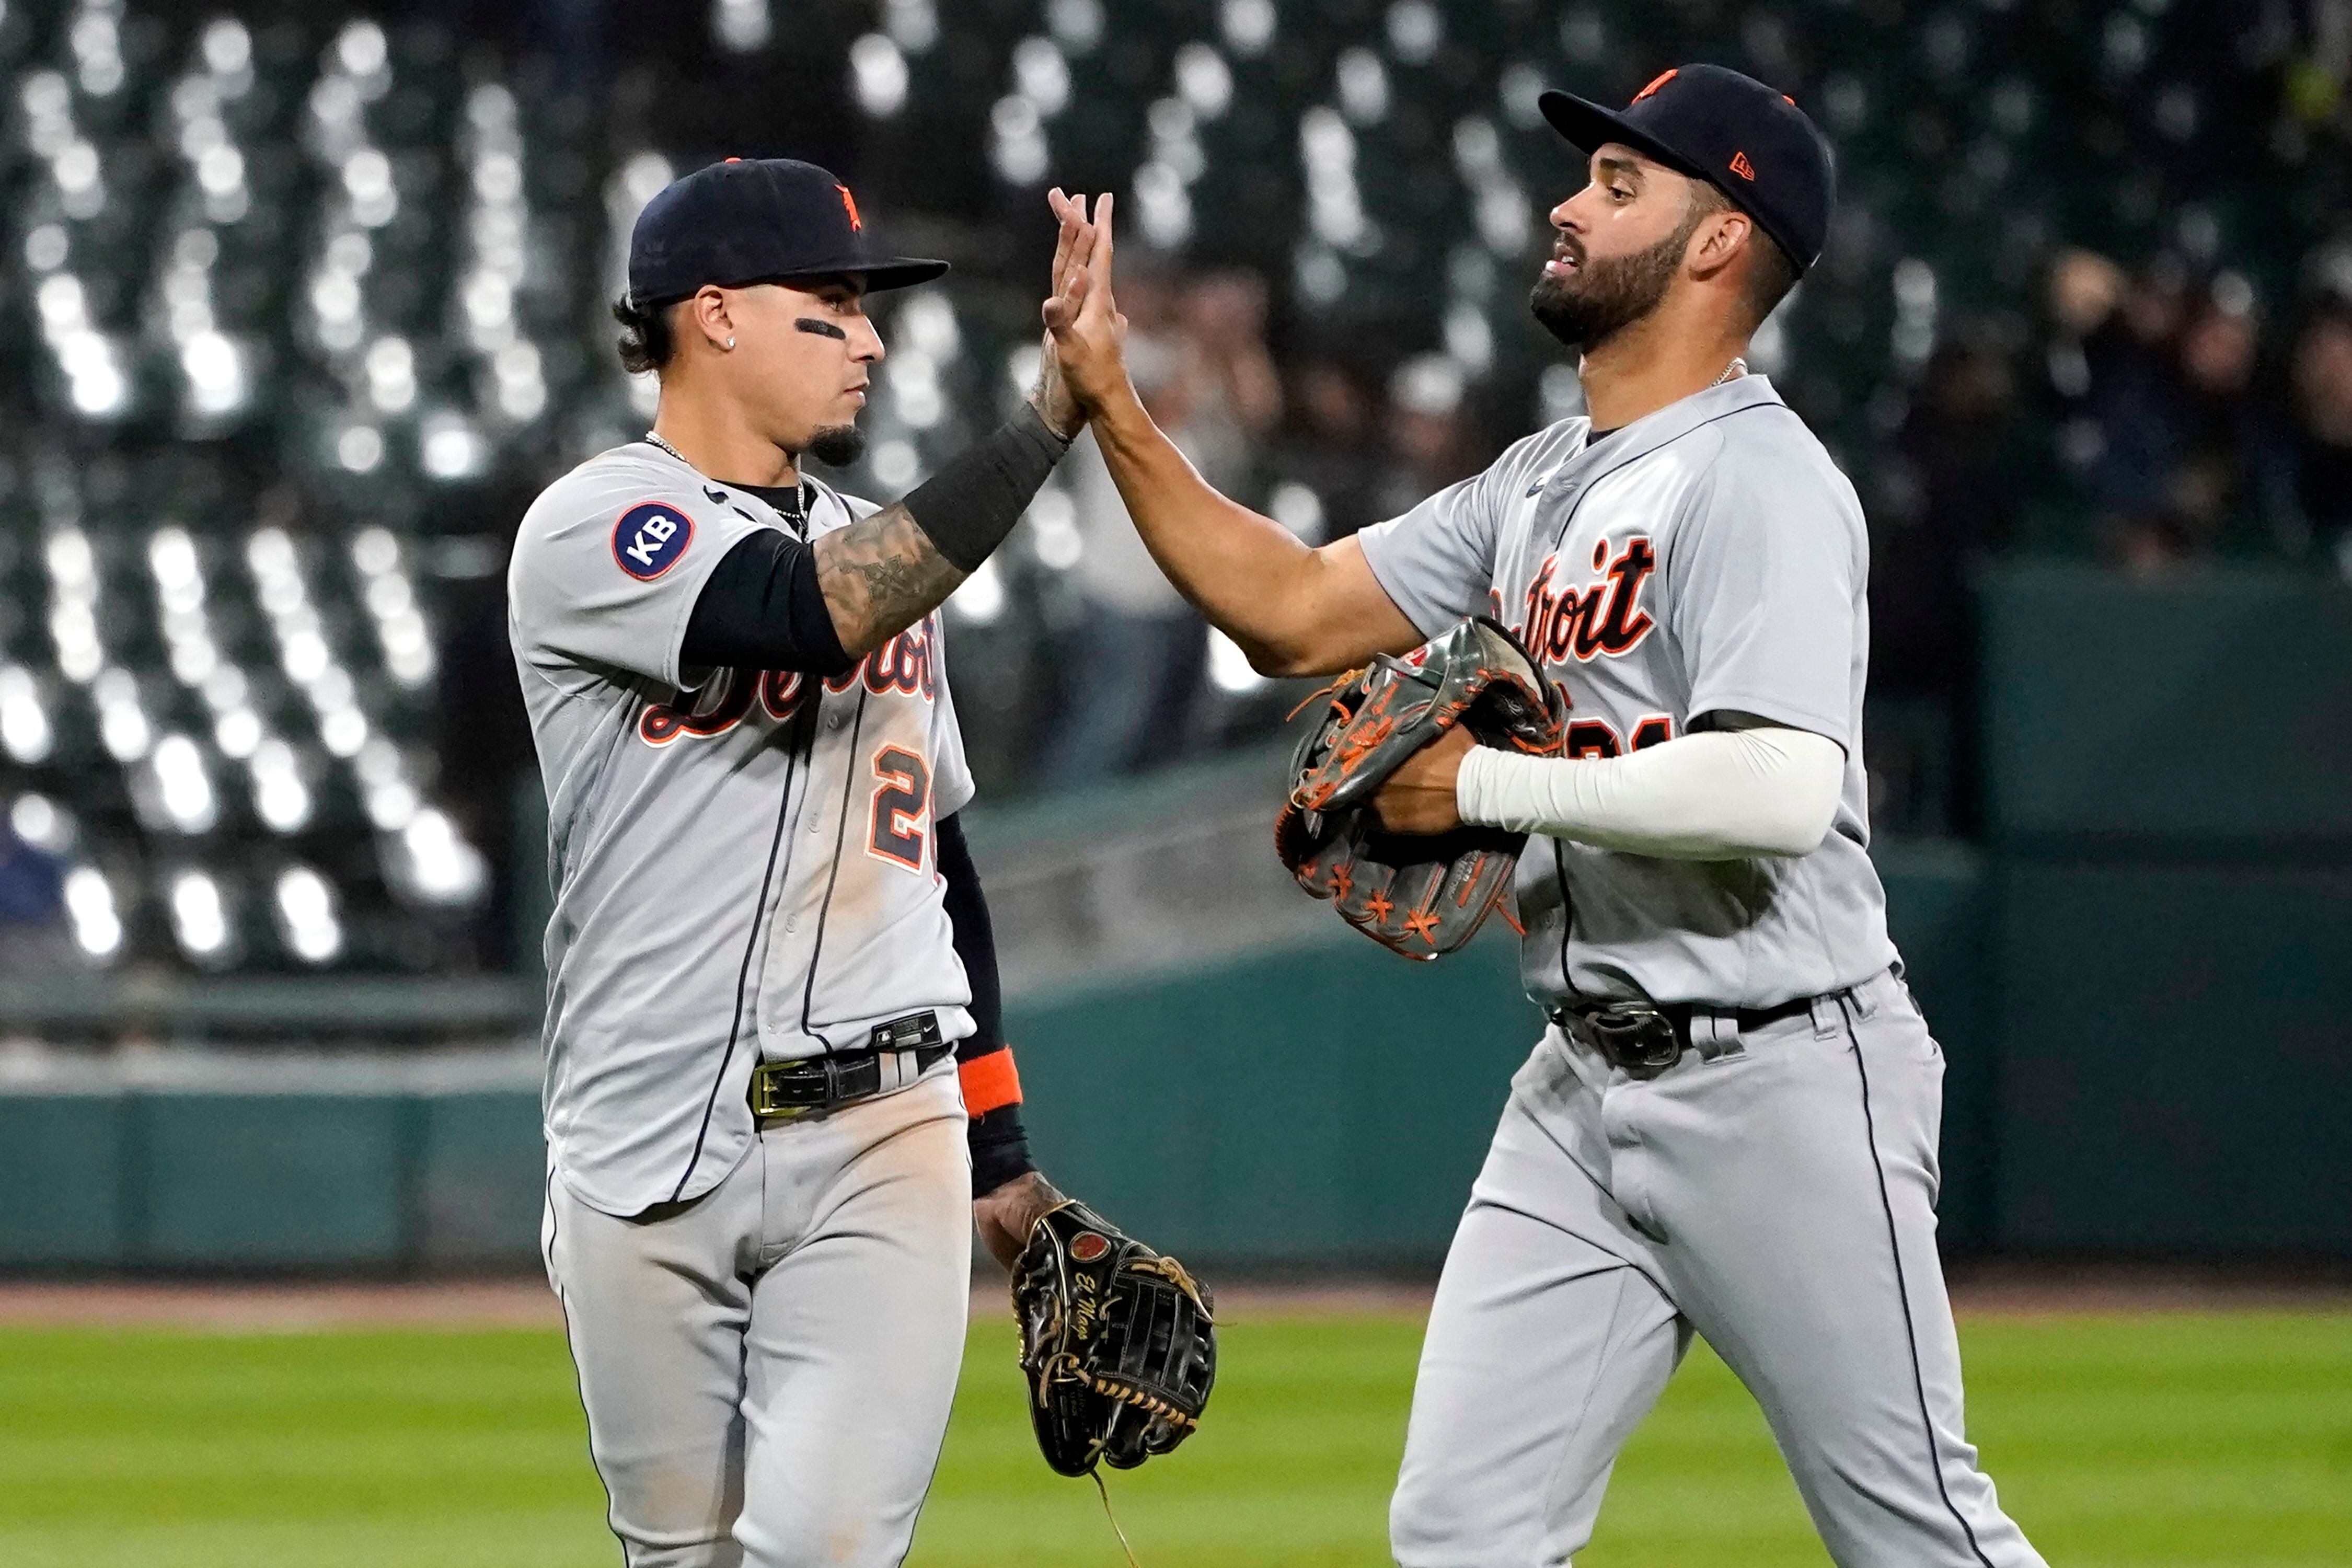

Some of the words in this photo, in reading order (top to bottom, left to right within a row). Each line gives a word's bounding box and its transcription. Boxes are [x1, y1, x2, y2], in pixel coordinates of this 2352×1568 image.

[627, 515, 677, 566] KB
[1490, 535, 1656, 668] troit
[864, 741, 939, 887] 2
